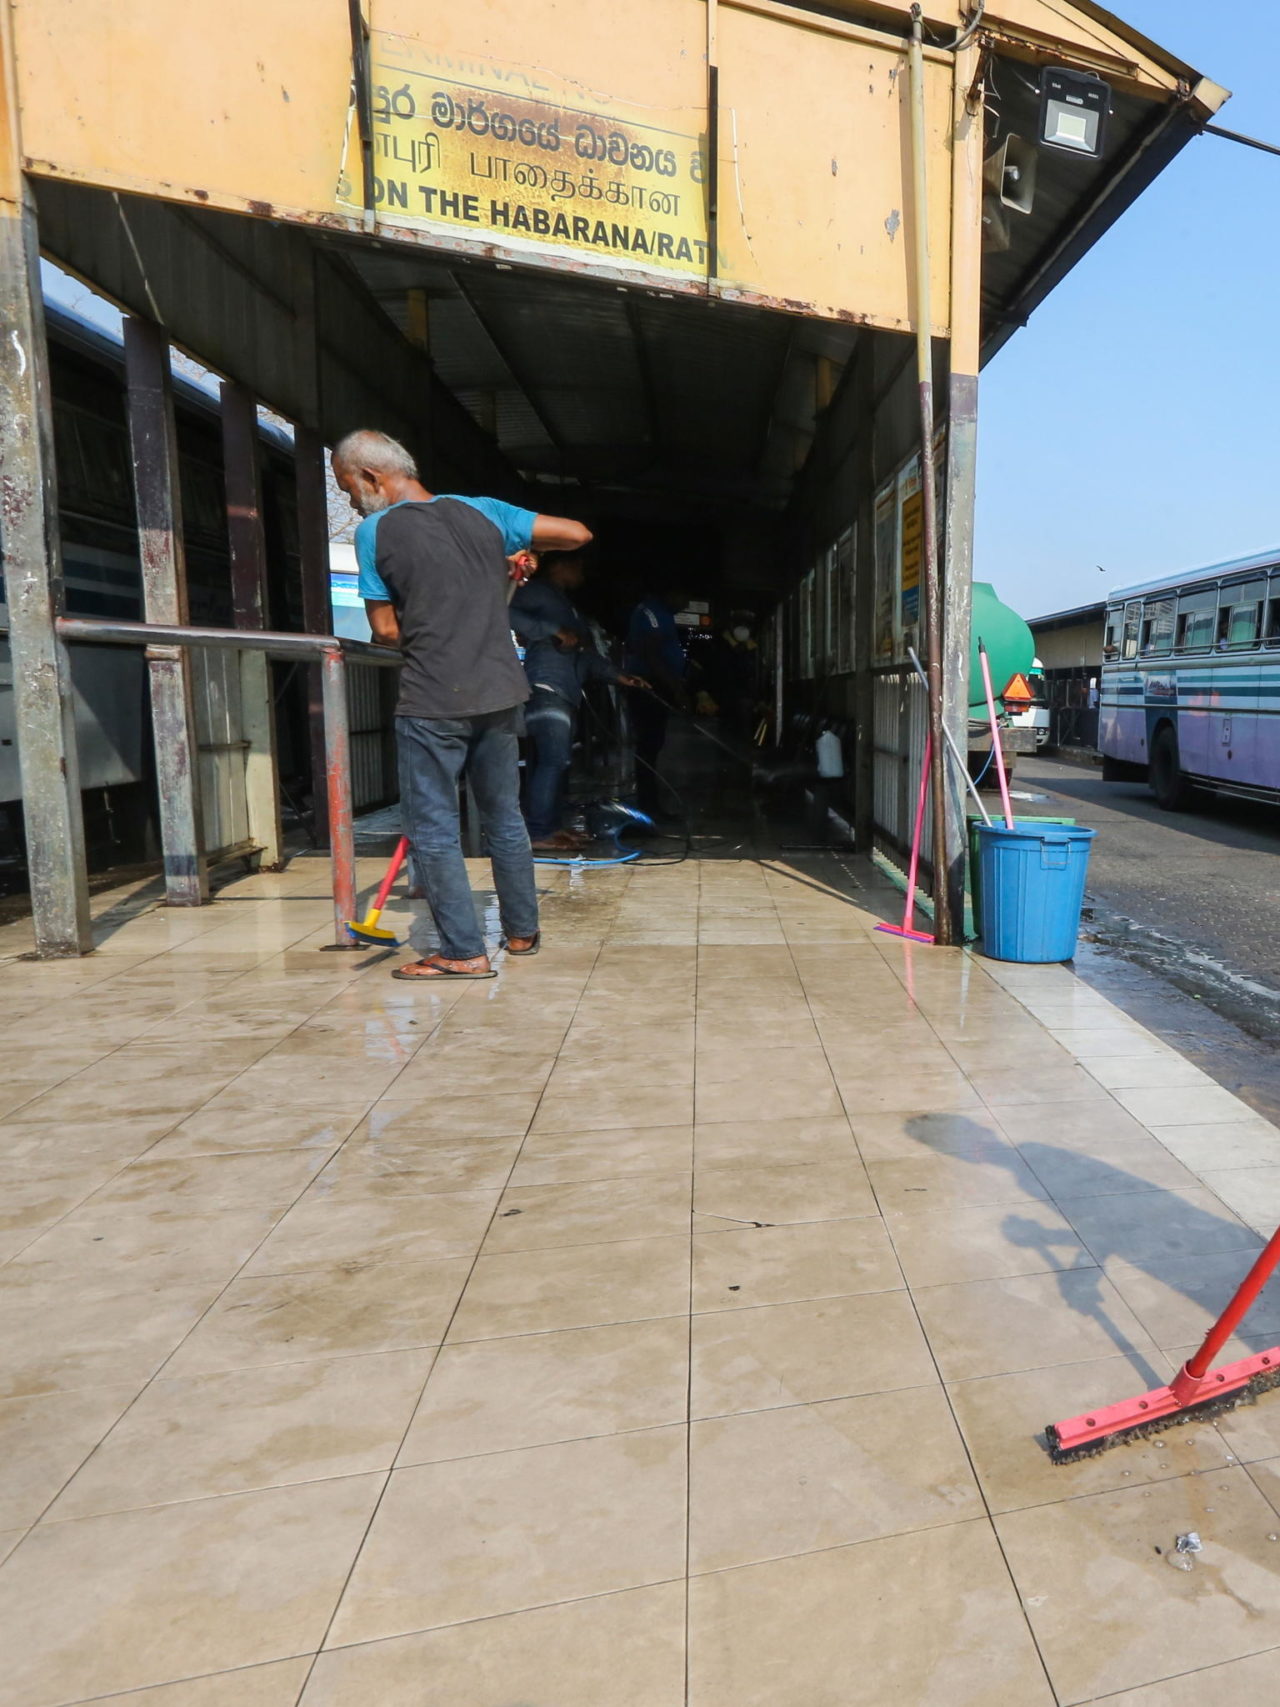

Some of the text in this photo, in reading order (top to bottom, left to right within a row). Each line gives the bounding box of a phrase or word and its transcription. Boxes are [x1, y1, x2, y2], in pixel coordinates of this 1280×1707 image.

[432, 92, 561, 151] මාර්ගයේ
[575, 124, 677, 177] ධාවනය
[418, 185, 480, 222] THE
[470, 151, 680, 217] பாதைக்கான
